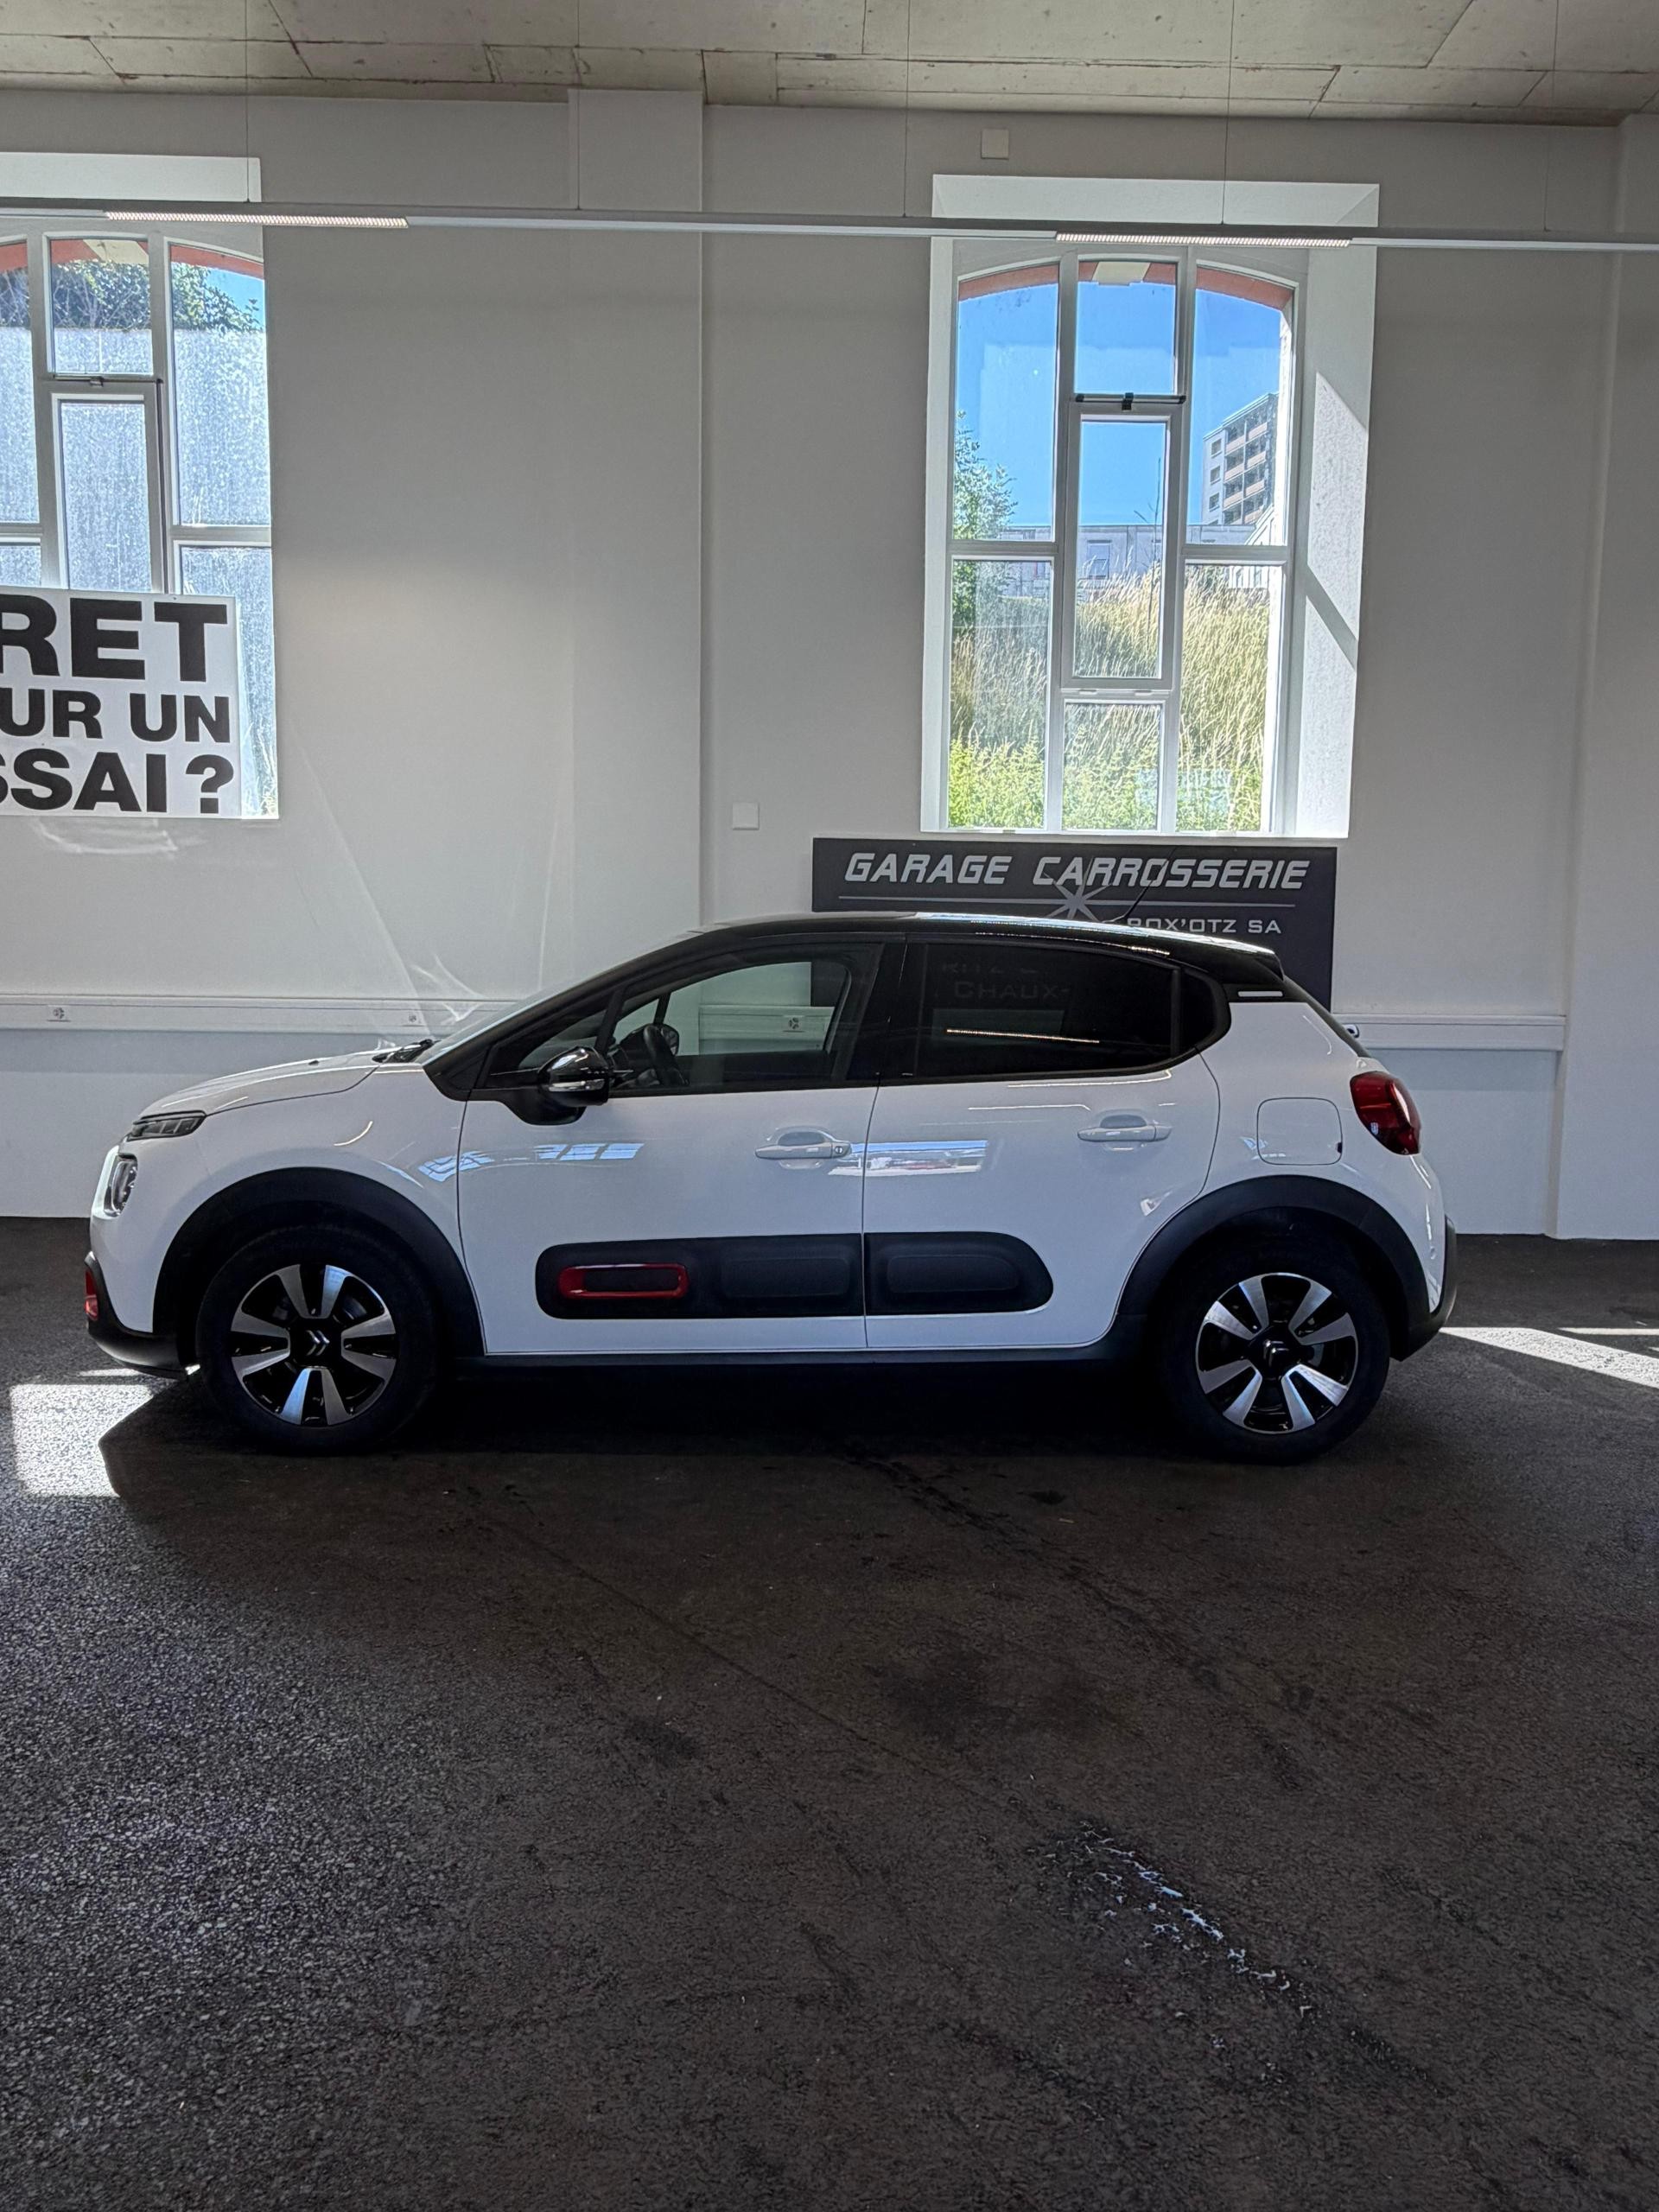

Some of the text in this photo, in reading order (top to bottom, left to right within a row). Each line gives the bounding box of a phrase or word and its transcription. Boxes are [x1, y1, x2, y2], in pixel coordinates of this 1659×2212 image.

[0, 594, 228, 682] RET
[0, 688, 230, 743] UR UN
[844, 852, 1311, 889] GARAGE CARROSSERIE
[1248, 919, 1281, 934] SA
